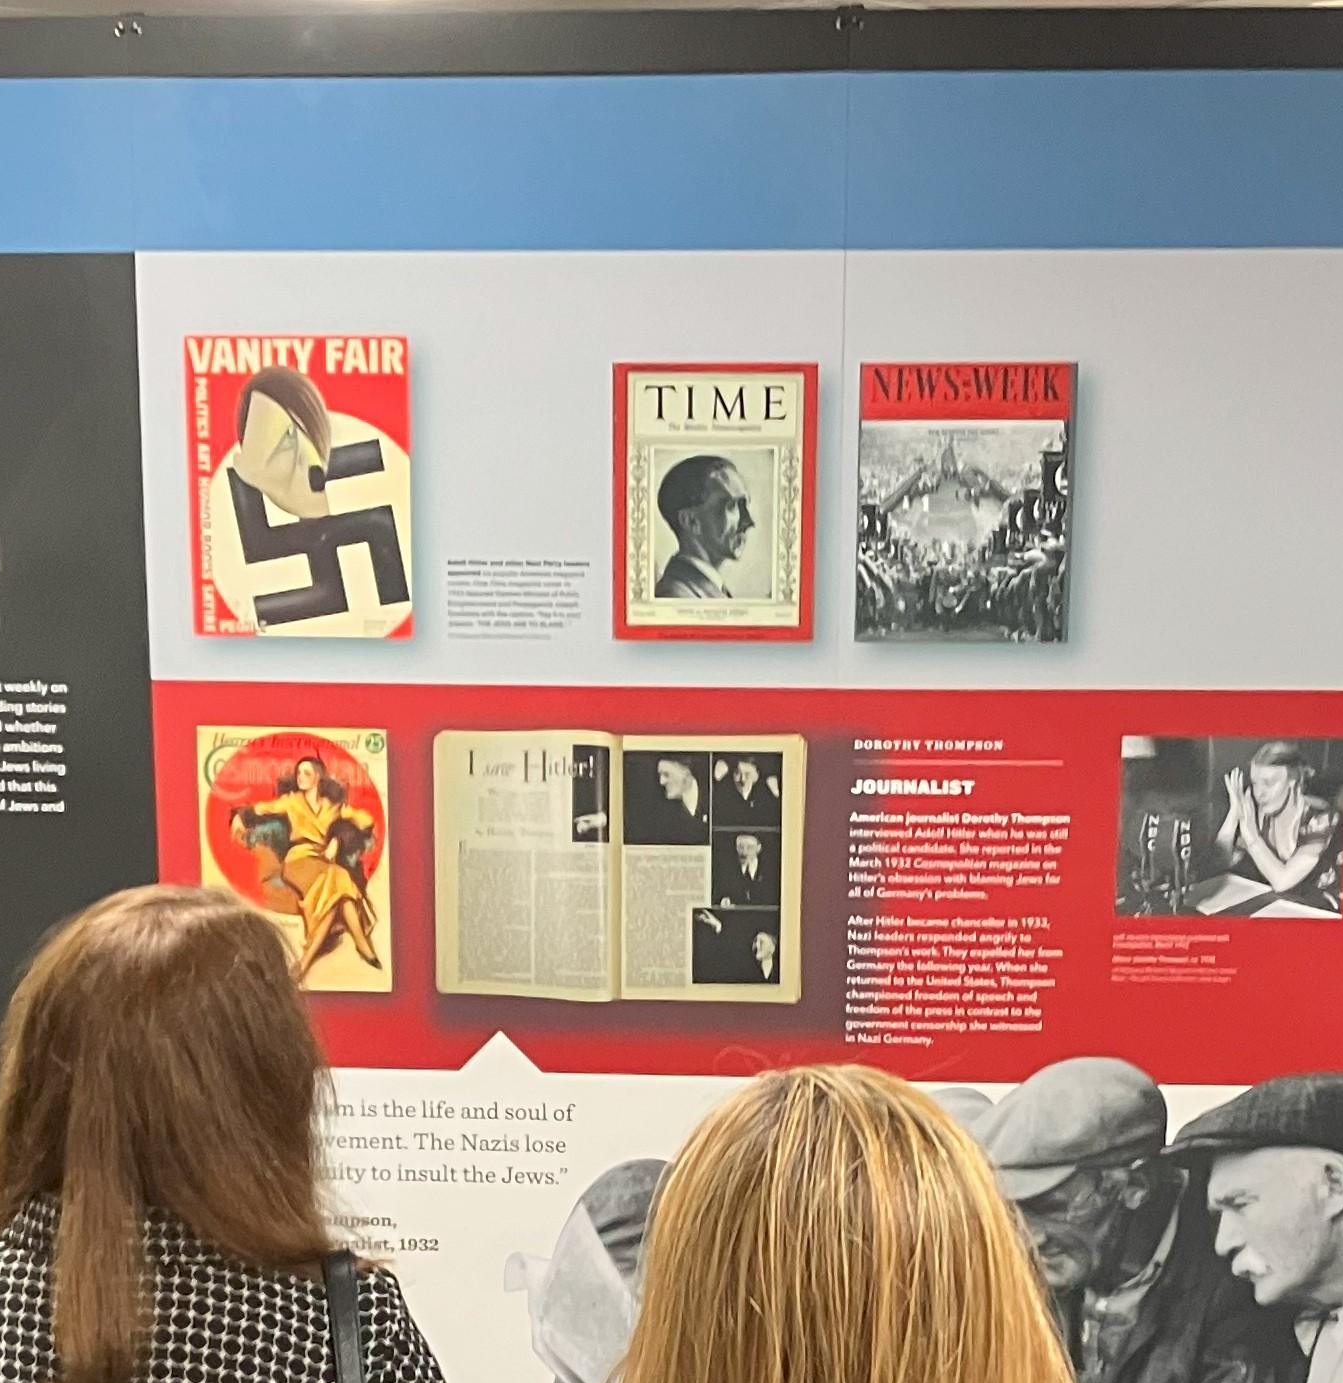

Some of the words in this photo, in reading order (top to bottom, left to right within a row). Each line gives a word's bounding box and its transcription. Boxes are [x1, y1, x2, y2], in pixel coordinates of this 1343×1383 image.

[186, 337, 314, 375] VANITY
[325, 338, 405, 375] FAIR
[644, 384, 787, 421] TIME
[197, 444, 211, 471] ART
[4, 680, 48, 696] weekly
[51, 682, 68, 694] on
[25, 701, 67, 714] stories
[5, 720, 57, 734] whether
[854, 740, 921, 751] DOROTHY
[925, 740, 1004, 751] THOMPSON
[468, 749, 475, 776] I
[523, 749, 594, 783] Hitler!
[851, 779, 976, 795] JOURNALIST
[849, 812, 904, 824] American
[905, 811, 960, 825] journalist
[961, 812, 1009, 826] Dorothy
[1011, 812, 1071, 826] Thompson
[849, 827, 913, 838] interviewed
[914, 827, 945, 838] Adolf
[946, 827, 976, 839] Hitler
[978, 828, 1008, 839] when
[1010, 828, 1024, 839] he
[1026, 830, 1048, 839] was
[1049, 828, 1069, 839] still
[849, 845, 856, 853] a
[858, 842, 900, 854] political
[959, 843, 980, 855] She
[981, 843, 1030, 856] reported
[1031, 844, 1042, 854] in
[1043, 844, 1063, 855] the
[360, 1098, 377, 1117] is
[383, 1099, 416, 1118] the
[421, 1100, 455, 1119] life
[460, 1101, 499, 1120] and
[504, 1102, 547, 1122] soul
[553, 1103, 576, 1123] of
[320, 1134, 408, 1150] vement.
[413, 1132, 455, 1150] The
[461, 1133, 520, 1152] Nazis
[525, 1134, 567, 1153] lose
[371, 1166, 392, 1182] to
[397, 1163, 457, 1183] insult
[463, 1164, 496, 1184] the
[399, 1238, 439, 1251] 1932
